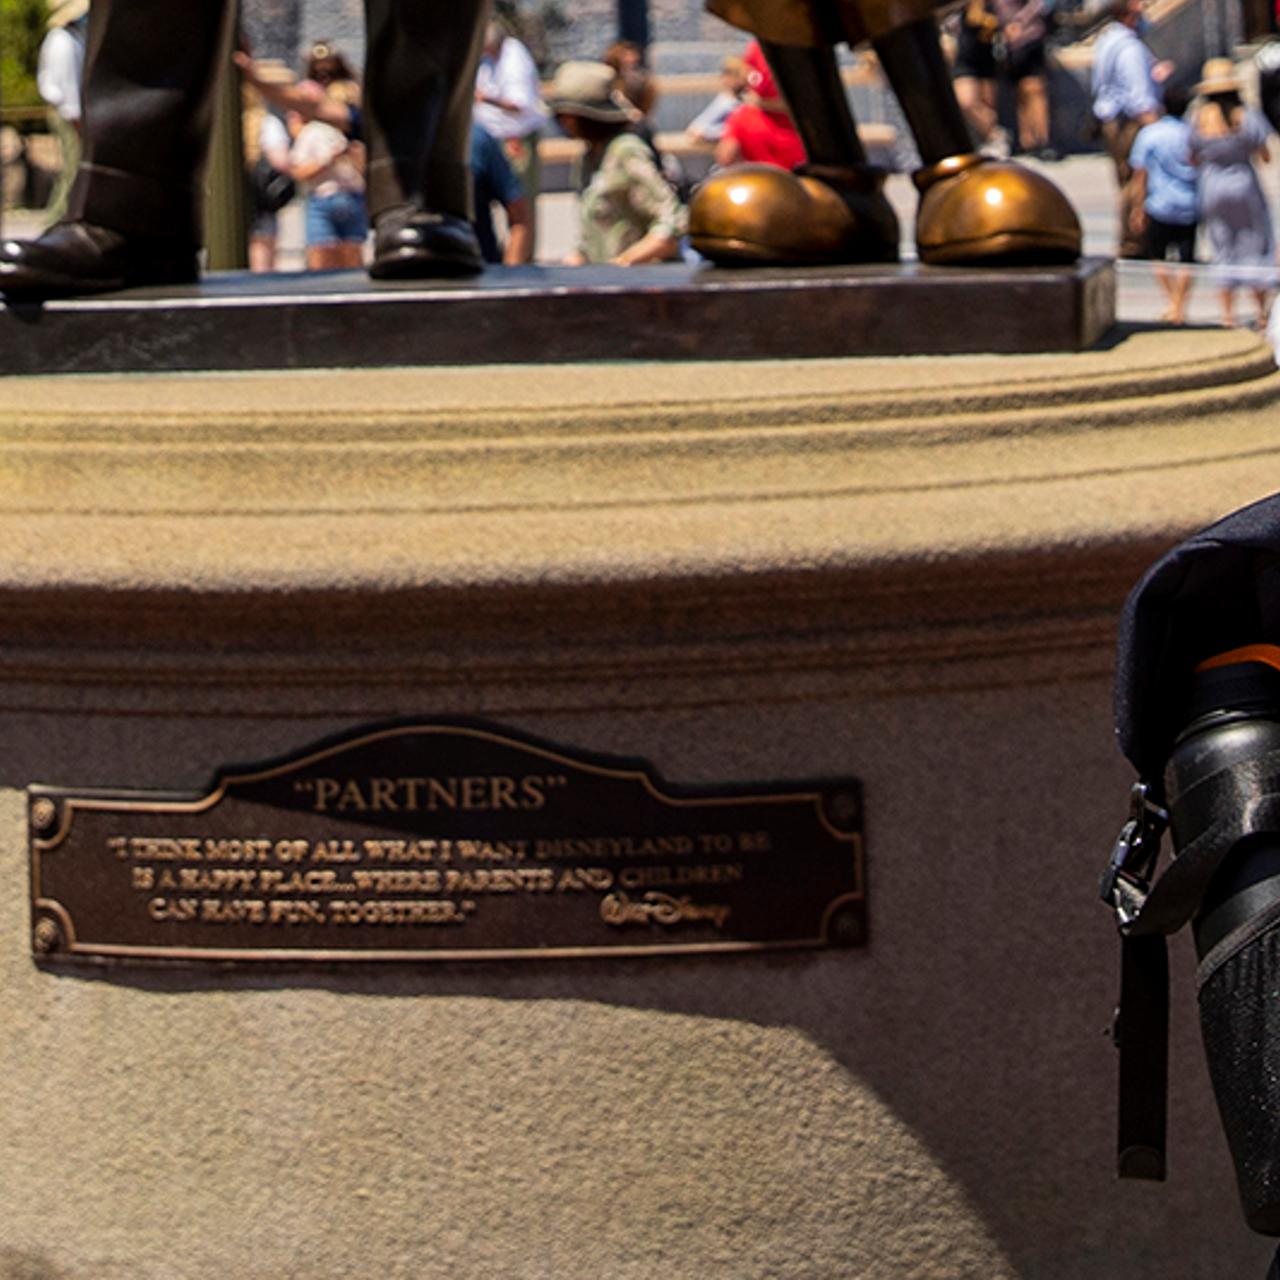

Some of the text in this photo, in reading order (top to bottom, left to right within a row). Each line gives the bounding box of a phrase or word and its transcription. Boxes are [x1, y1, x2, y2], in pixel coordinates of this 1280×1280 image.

[205, 838, 272, 862] MOST
[274, 839, 310, 862] OF
[311, 839, 361, 862] ALL
[363, 839, 438, 862] WHAT
[439, 839, 453, 862] I
[454, 839, 526, 861] WANT
[534, 835, 693, 860] DISNEYLAND
[697, 834, 733, 852] TO
[158, 868, 177, 889] A
[178, 868, 256, 890] HAPPY
[442, 868, 554, 892] PARENTS
[556, 866, 615, 890] AND
[621, 864, 743, 888] CHILDREN
[147, 896, 199, 921] CAN
[200, 898, 267, 924] HAVE
